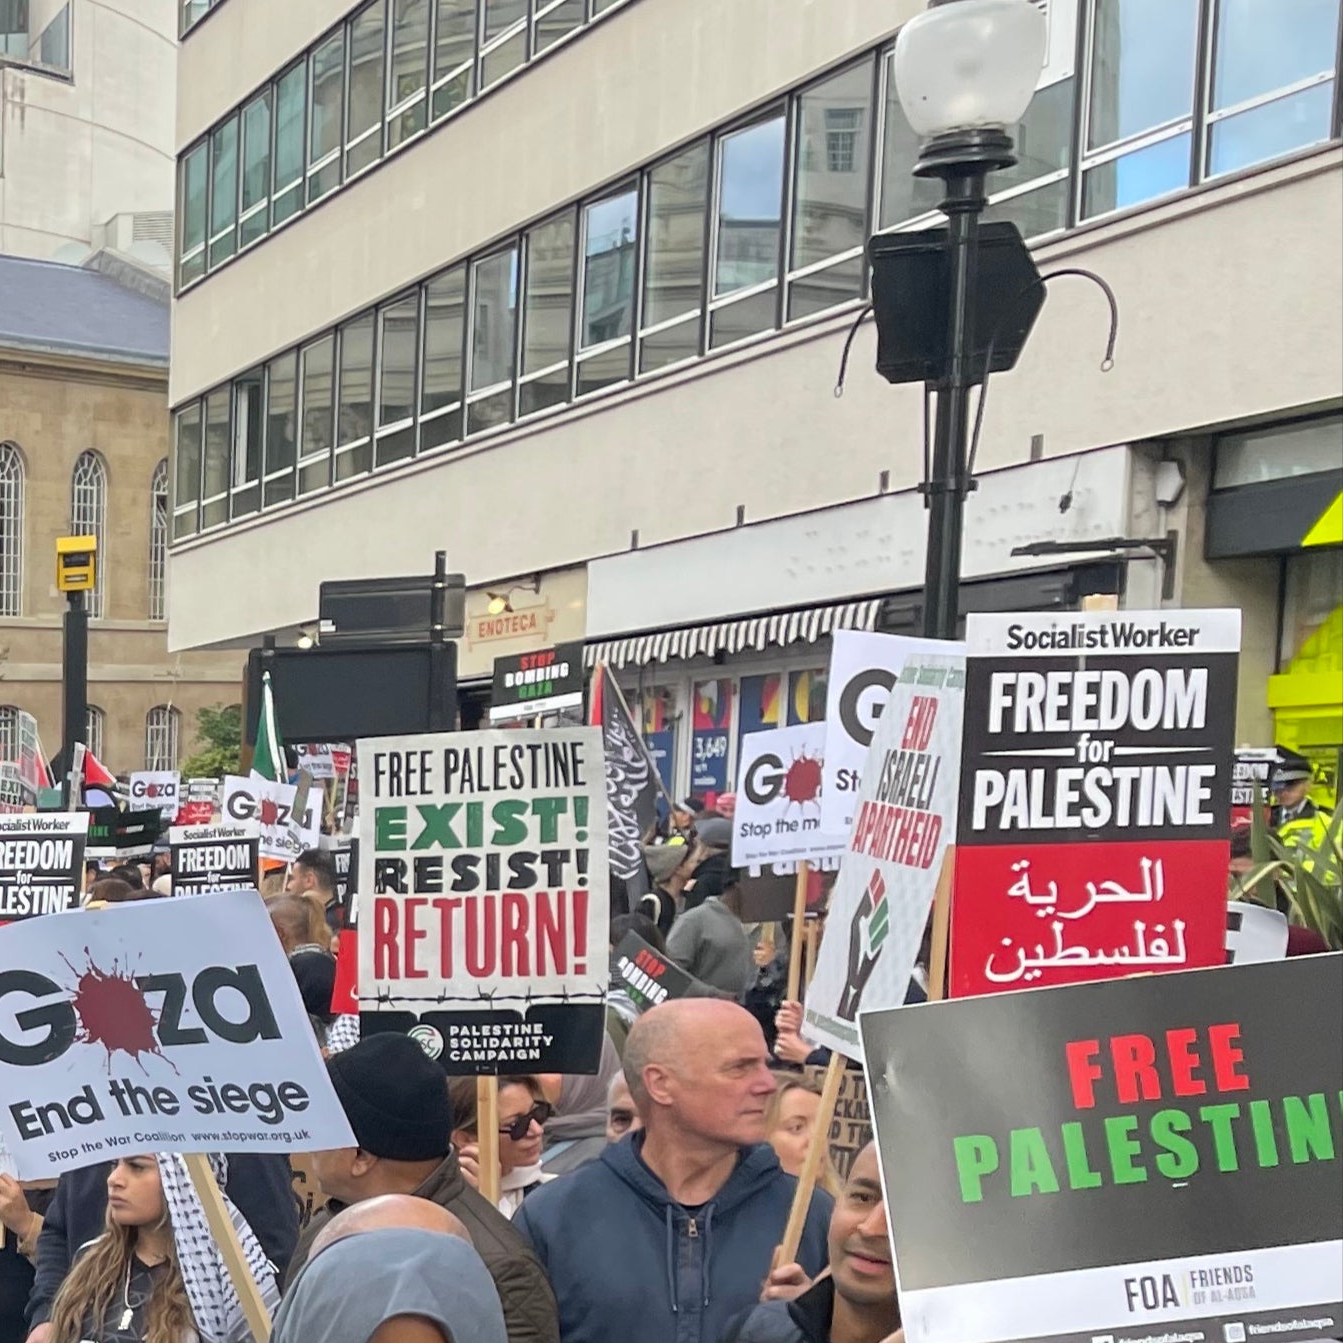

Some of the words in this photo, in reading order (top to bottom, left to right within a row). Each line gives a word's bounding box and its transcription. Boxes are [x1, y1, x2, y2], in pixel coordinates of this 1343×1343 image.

[478, 613, 537, 638] ENOTECA
[505, 663, 569, 688] BOMBING
[519, 651, 555, 670] STOP
[901, 695, 938, 751] END
[988, 667, 1209, 734] FREEDOM
[373, 749, 433, 798] FREE
[444, 741, 587, 795] PALESTINE
[1074, 732, 1115, 764] for
[876, 748, 941, 811] ISRAELI
[971, 764, 1215, 830] PALESTINE
[375, 796, 589, 852] EXIST!
[740, 821, 772, 839] Stop
[775, 817, 799, 834] the
[851, 800, 943, 870] APARTHEID
[16, 870, 32, 886] for
[178, 844, 250, 873] FREEDOM
[207, 872, 221, 885] for
[375, 847, 589, 895] RESIST!
[1007, 857, 1164, 919] الحرية
[373, 889, 587, 981] RETURN!
[984, 920, 1187, 983] لفلسطين
[634, 948, 667, 978] STOP
[450, 1023, 543, 1037] PALESTINE
[450, 1034, 554, 1050] SOLIDARITY
[450, 1047, 541, 1063] CAMPAIGN
[1065, 1022, 1250, 1109] FREE
[10, 1096, 104, 1142] End
[108, 1078, 182, 1117] the
[187, 1075, 310, 1126] siege
[48, 1148, 78, 1165] Stop
[81, 1142, 103, 1157] the
[105, 1135, 131, 1150] War
[134, 1131, 186, 1147] Coalition
[191, 1128, 312, 1145] www.stopwar.org.uk
[953, 1091, 1343, 1203] PALESTIN
[1124, 1274, 1180, 1312] FOA
[1190, 1264, 1254, 1288] FRIENDS
